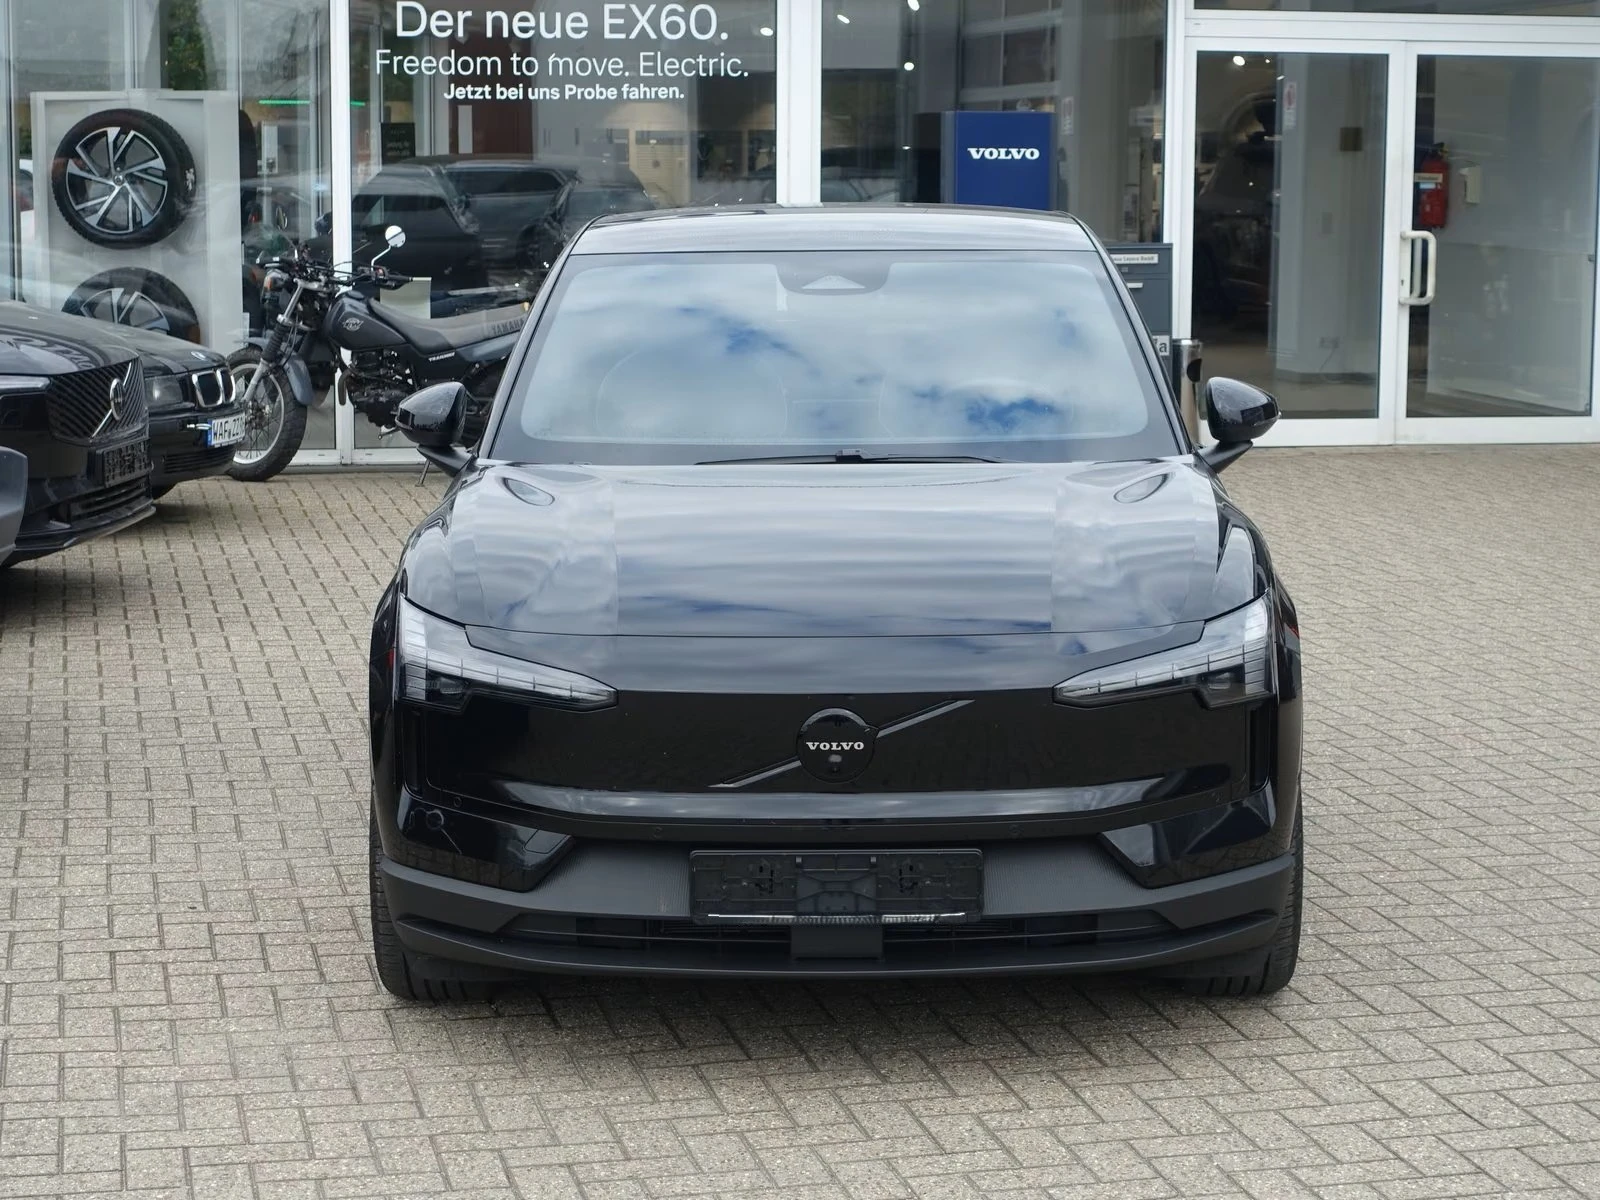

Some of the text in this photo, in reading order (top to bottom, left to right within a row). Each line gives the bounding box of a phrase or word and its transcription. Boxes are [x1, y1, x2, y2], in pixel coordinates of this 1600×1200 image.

[396, 0, 729, 41] Der neue EX60.
[375, 49, 750, 78] Freedom to move. Electric.
[443, 83, 685, 101] Jetzt bei uns Probe fahren.
[967, 147, 1041, 161] VOLVO
[805, 741, 865, 751] VOLVO
